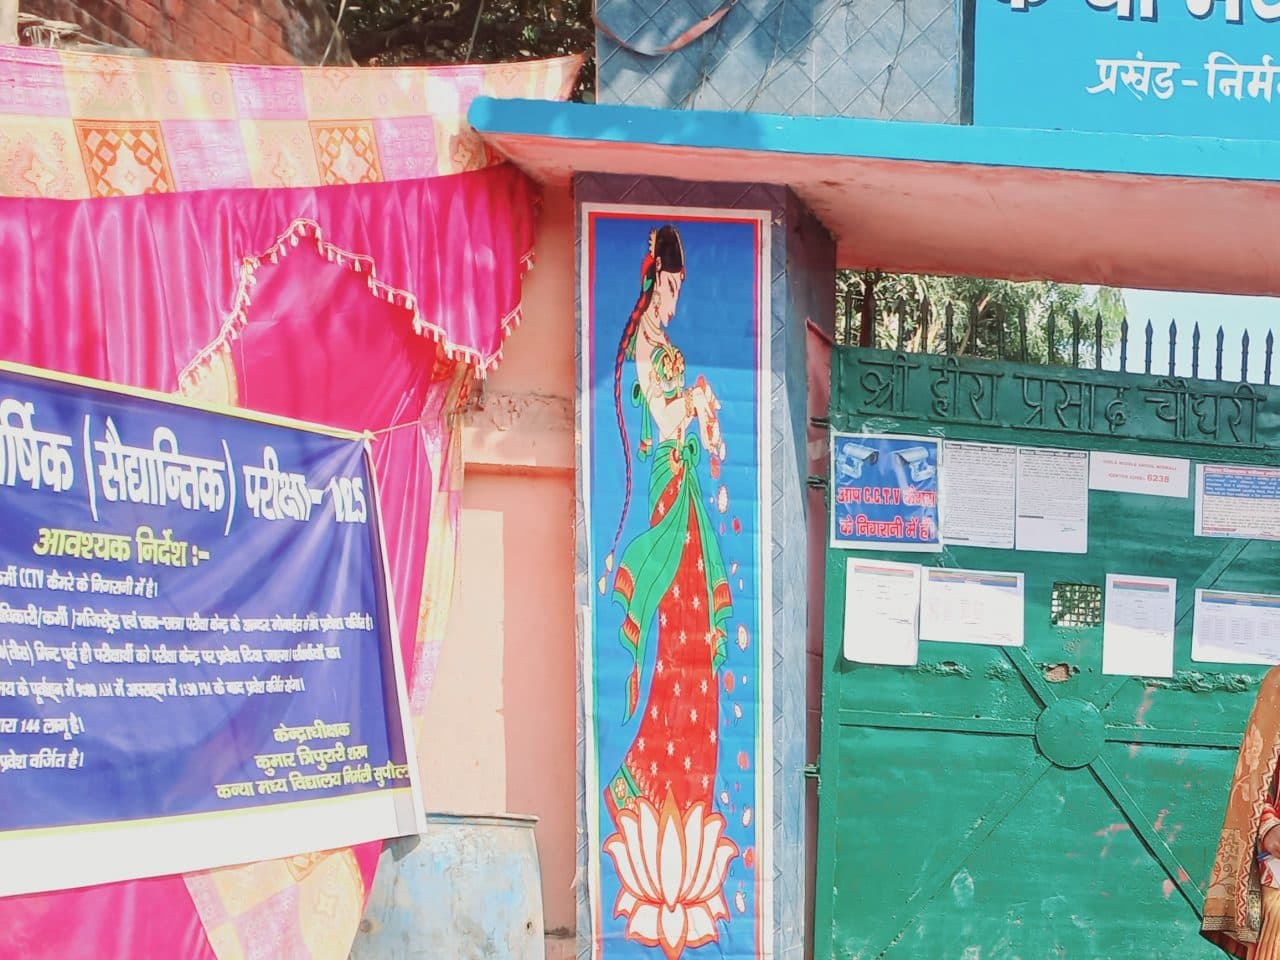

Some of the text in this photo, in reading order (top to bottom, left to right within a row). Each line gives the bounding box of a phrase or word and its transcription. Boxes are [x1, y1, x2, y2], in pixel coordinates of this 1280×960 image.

[837, 487, 862, 504] आप
[33, 528, 132, 562] आवश्यक
[20, 567, 44, 589] CCTV
[254, 752, 296, 776] कुमार
[214, 781, 255, 800] कन्या
[288, 771, 342, 792] विद्यालय
